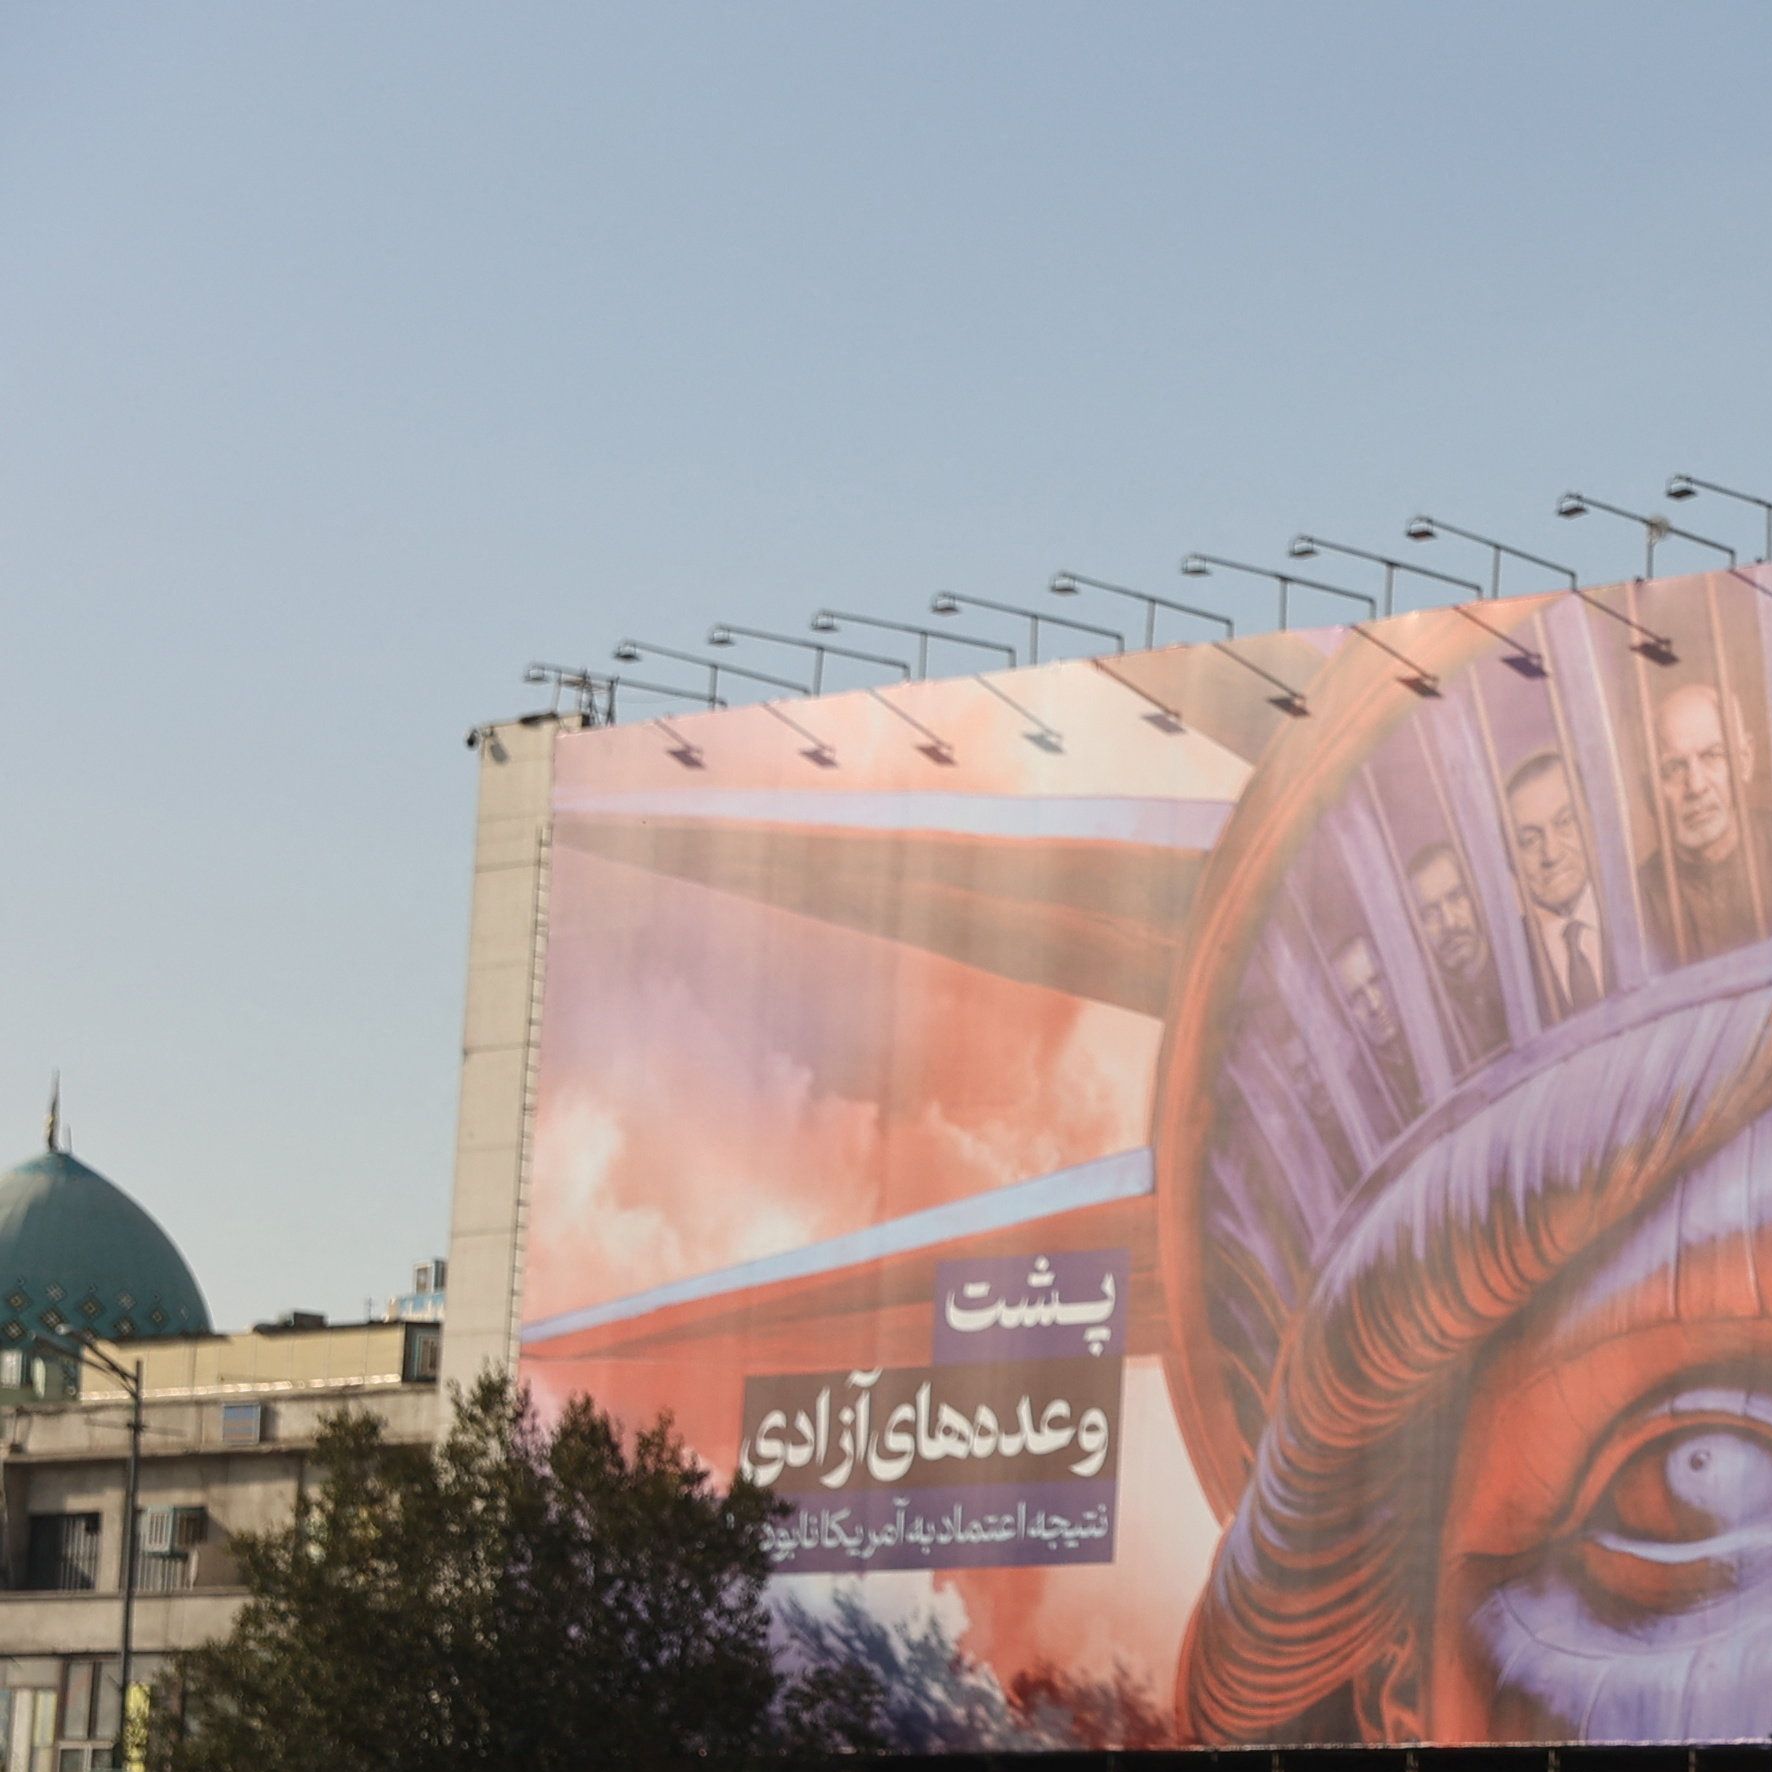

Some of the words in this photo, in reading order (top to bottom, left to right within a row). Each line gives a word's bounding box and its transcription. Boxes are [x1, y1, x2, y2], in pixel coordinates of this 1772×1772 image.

[944, 1254, 1116, 1357] پشت
[740, 1367, 884, 1488] آزادی
[819, 1496, 911, 1559] آمریکا
[905, 1515, 936, 1554] به
[936, 1500, 1028, 1544] اعتماد
[1028, 1502, 1109, 1550] نتیجه
